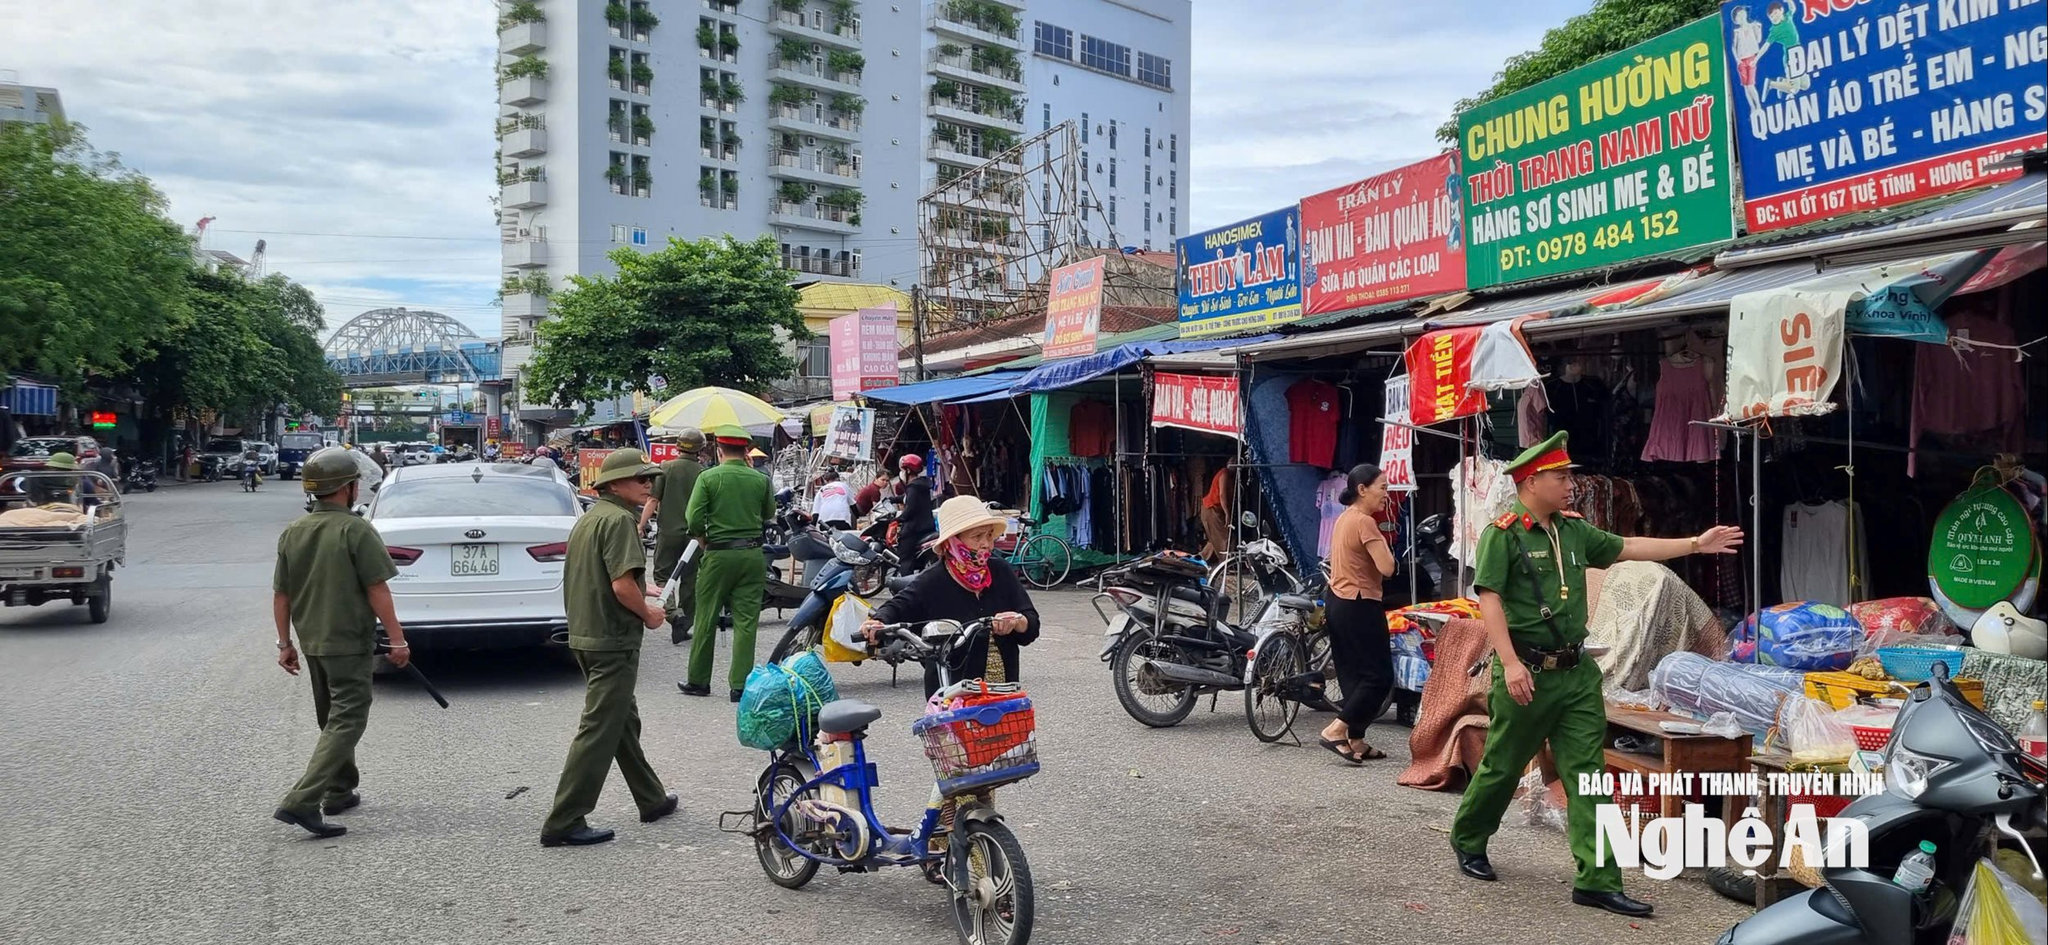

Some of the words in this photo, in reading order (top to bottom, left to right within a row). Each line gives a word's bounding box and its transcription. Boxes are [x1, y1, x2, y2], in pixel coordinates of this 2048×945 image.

[1787, 36, 1833, 79] ĐẠI
[1838, 17, 1870, 62] LÝ
[1877, 2, 1930, 51] DỆT
[1937, 0, 1999, 32] KIM
[1467, 94, 1570, 160] CHUNG
[1579, 42, 1711, 125] HƯỜNG
[1827, 79, 1862, 119] ÁO
[1868, 53, 1920, 106] TRẺ
[1926, 47, 1974, 90] EM
[1468, 160, 1515, 206] THỜI
[1518, 139, 1595, 193] TRANG
[1599, 116, 1663, 169] NAM
[1668, 94, 1715, 150] NỮ
[1775, 144, 1816, 182] MẸ
[1819, 129, 1857, 170] VÀ
[1861, 116, 1897, 161] BÉ
[1930, 97, 2015, 144] HÀNG
[1383, 173, 1404, 199] LÝ
[1472, 205, 1522, 246] HÀNG
[1526, 192, 1553, 233] SƠ
[1557, 181, 1608, 225] SINH
[1613, 169, 1650, 213] MẸ
[1656, 163, 1676, 200] &
[1682, 144, 1716, 194] BÉ
[1756, 204, 1781, 225] ĐC:
[1782, 199, 1799, 220] KI
[1820, 188, 1846, 211] 167
[1849, 177, 1878, 205] TUỆ
[1880, 172, 1915, 198] TĨNH
[1928, 158, 1974, 188] HƯNG
[1204, 220, 1262, 250] HANOSIMEX
[1311, 221, 1334, 266] BÁN
[1365, 206, 1390, 254] BÁN
[1393, 189, 1429, 251] QUẦN
[1432, 188, 1452, 237] ÁO
[1500, 246, 1532, 271] ĐT:
[1536, 231, 1587, 263] 0978
[1592, 220, 1634, 250] 484
[1640, 209, 1679, 240] 152
[1188, 248, 1237, 298] THỦY
[1243, 242, 1286, 288] LÂM
[1342, 268, 1356, 290] ÁO
[1389, 255, 1411, 279] CÁC
[1414, 252, 1440, 277] LOẠI
[453, 560, 497, 575] 664.46
[463, 545, 487, 559] 37A
[1983, 535, 2002, 545] ANH
